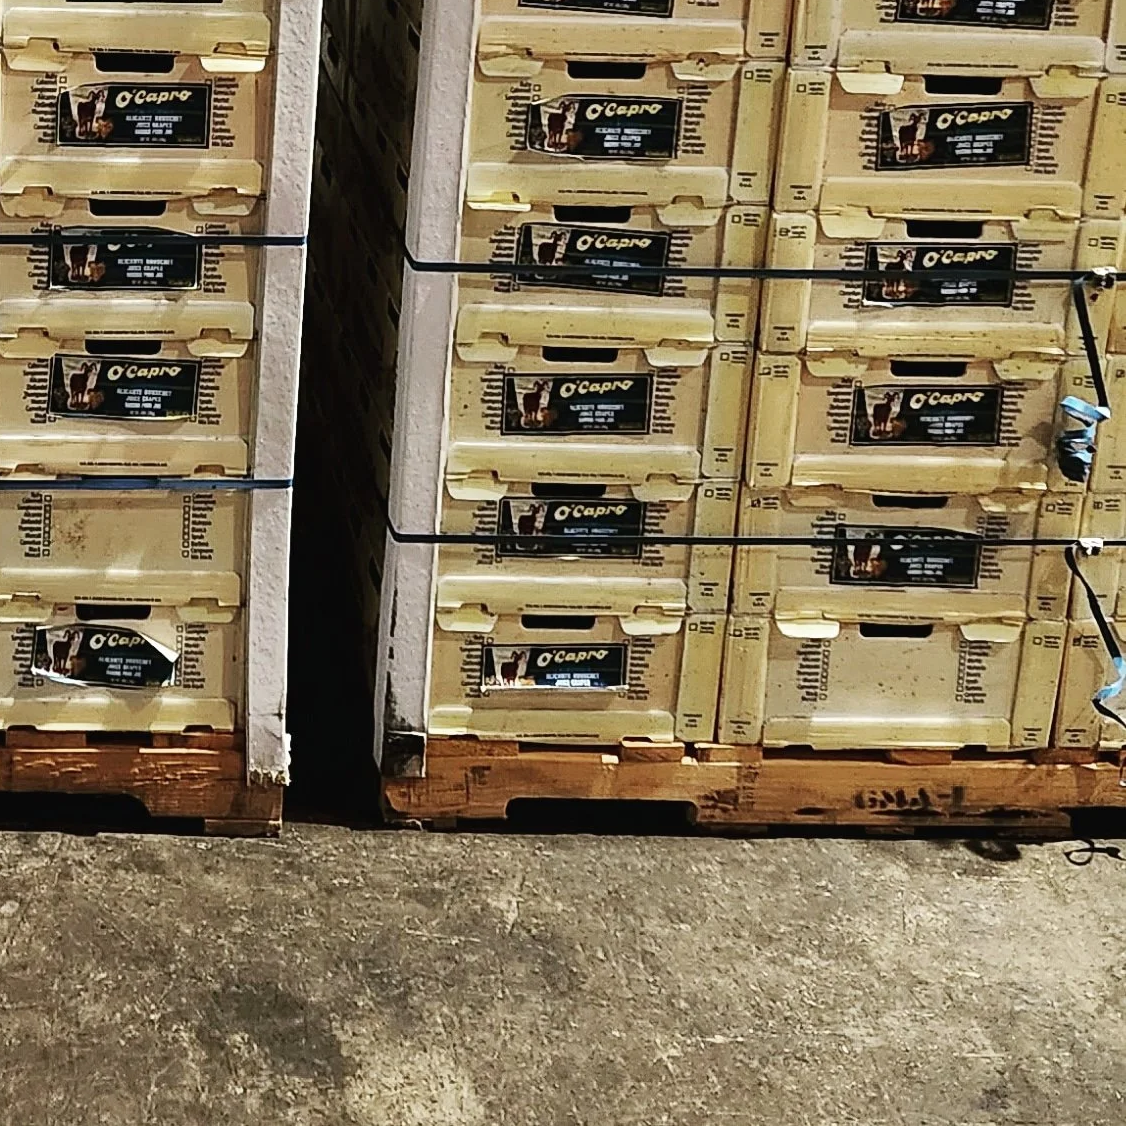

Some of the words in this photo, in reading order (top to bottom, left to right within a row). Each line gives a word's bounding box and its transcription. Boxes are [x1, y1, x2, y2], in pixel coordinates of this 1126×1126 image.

[115, 90, 192, 107] O'Capro
[586, 103, 662, 120] O'Capro
[936, 110, 1012, 129] O'Capro
[576, 235, 652, 251] O'Capro
[923, 251, 998, 268] O'Capro
[107, 365, 181, 380] O'Capro
[560, 379, 634, 397] O'Capro
[910, 393, 984, 409] O'Capro
[554, 504, 627, 520] O'Capro
[89, 633, 145, 649] O'Capr
[537, 649, 608, 666] O'Capro
